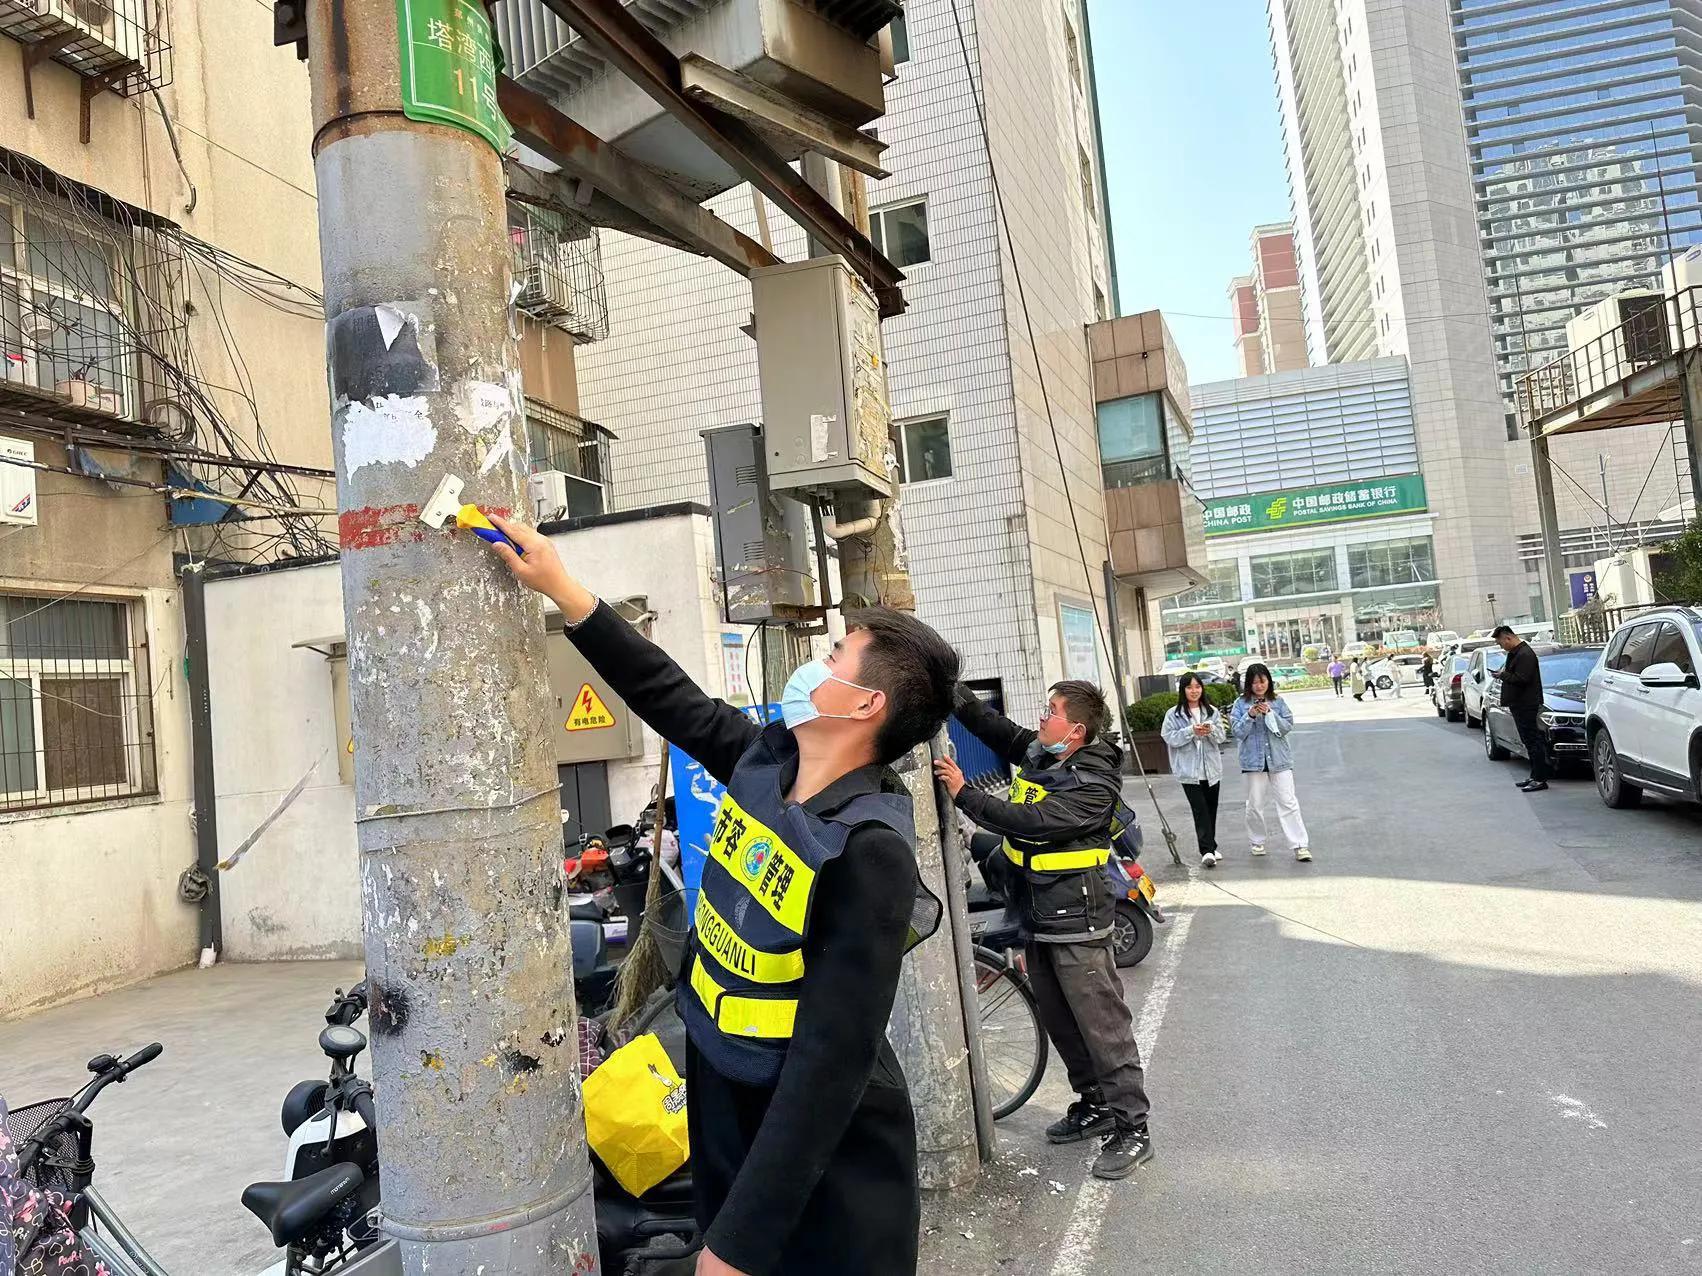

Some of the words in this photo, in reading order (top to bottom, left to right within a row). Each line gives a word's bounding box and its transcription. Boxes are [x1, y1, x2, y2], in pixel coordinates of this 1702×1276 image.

[427, 17, 495, 79] 塔湾西
[1293, 486, 1397, 509] 中国邮政储蓄银行
[1293, 508, 1318, 516] POSTAL
[1319, 505, 1347, 513] SAVINGS
[1348, 502, 1365, 510] BANK
[1377, 498, 1398, 506] CHINA
[1231, 515, 1252, 524] POST
[574, 715, 606, 726] 有电危险
[713, 807, 747, 860] 市容
[759, 850, 795, 911] 管理
